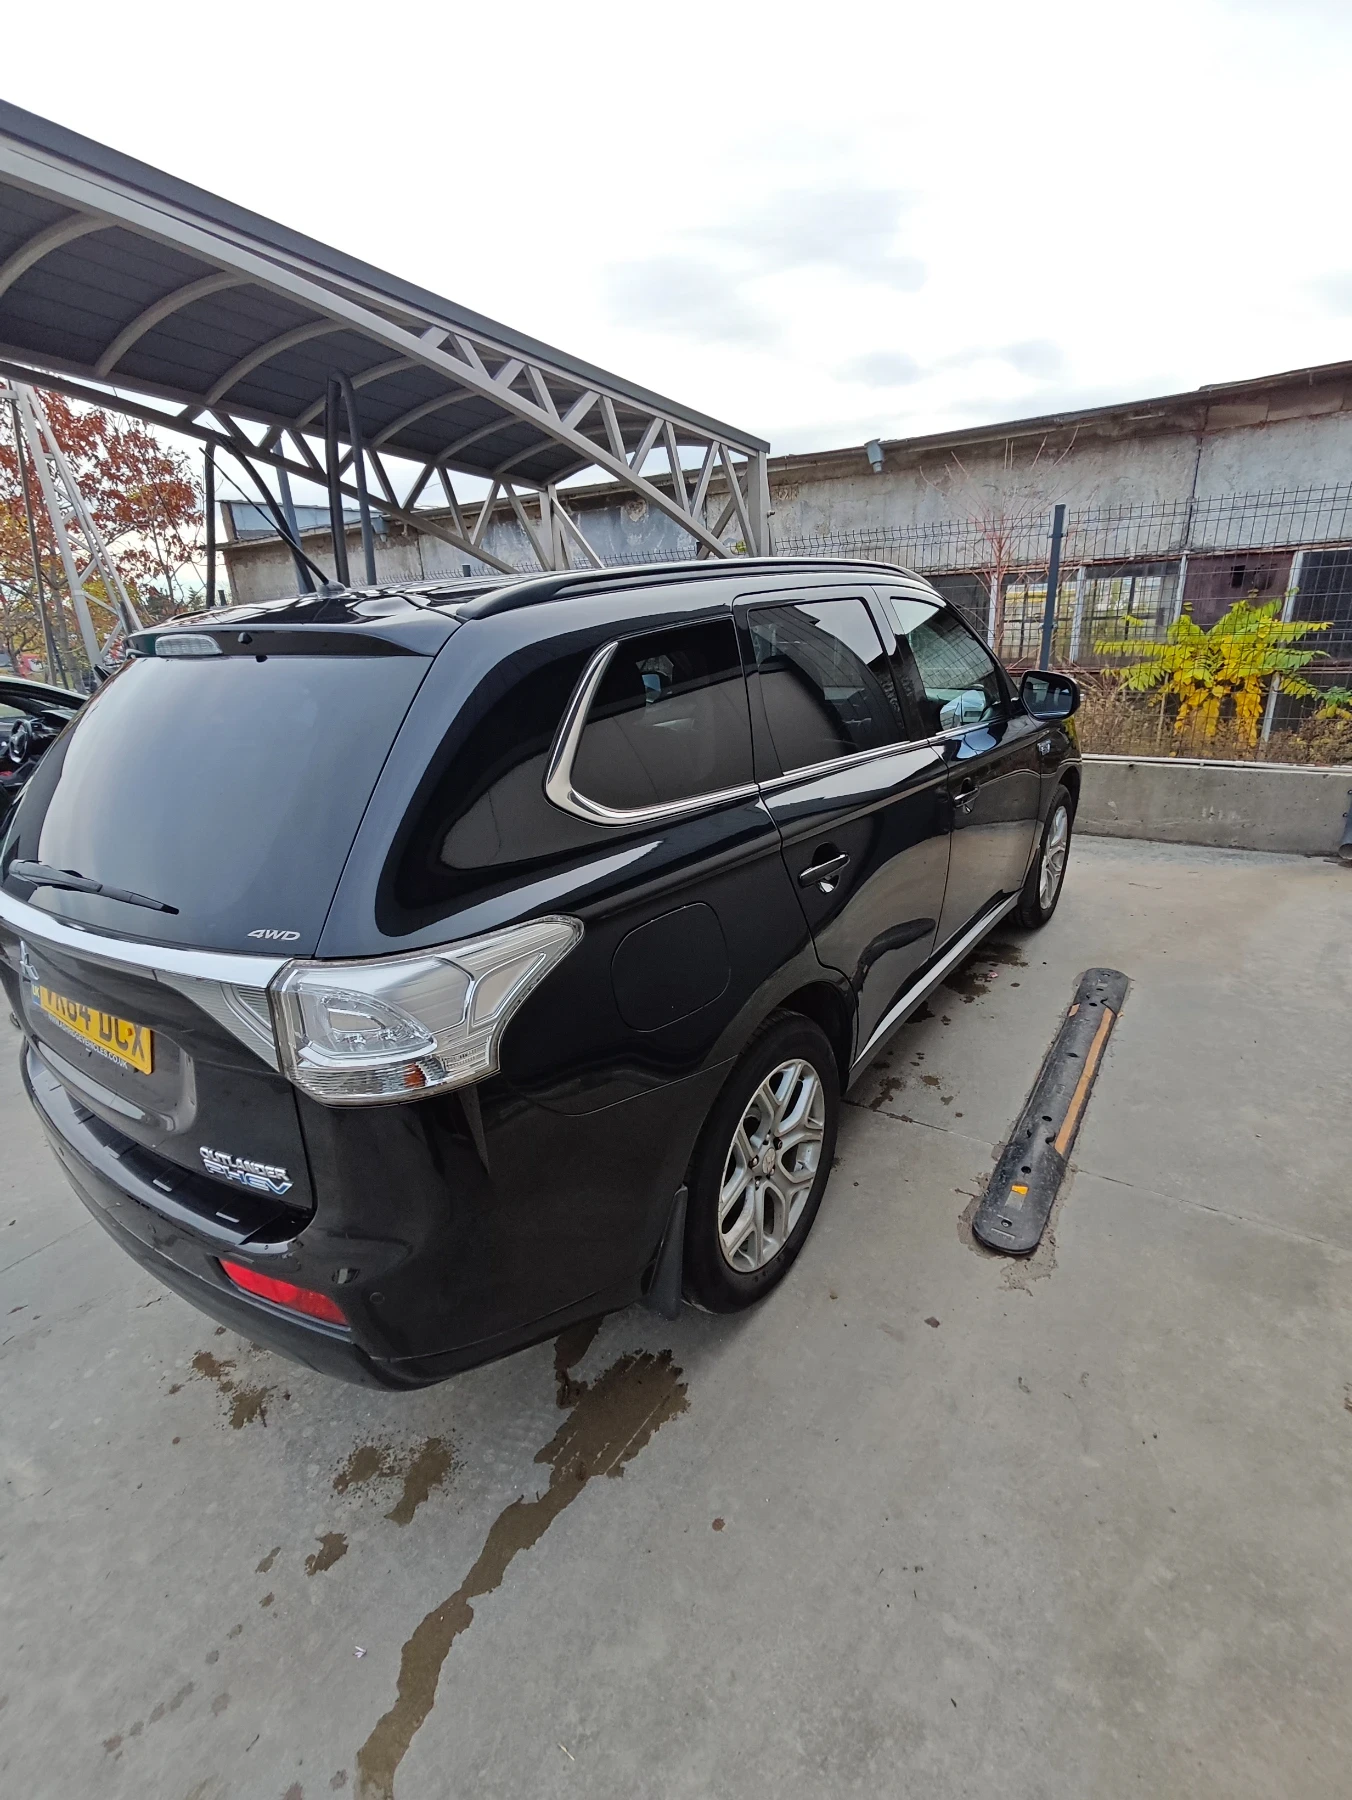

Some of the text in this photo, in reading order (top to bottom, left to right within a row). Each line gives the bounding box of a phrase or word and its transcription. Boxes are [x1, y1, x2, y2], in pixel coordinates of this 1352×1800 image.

[247, 929, 300, 940] 4WD
[99, 1012, 145, 1062] DCX
[200, 1146, 290, 1181] OUTLANDER
[203, 1159, 294, 1195] PHEV
